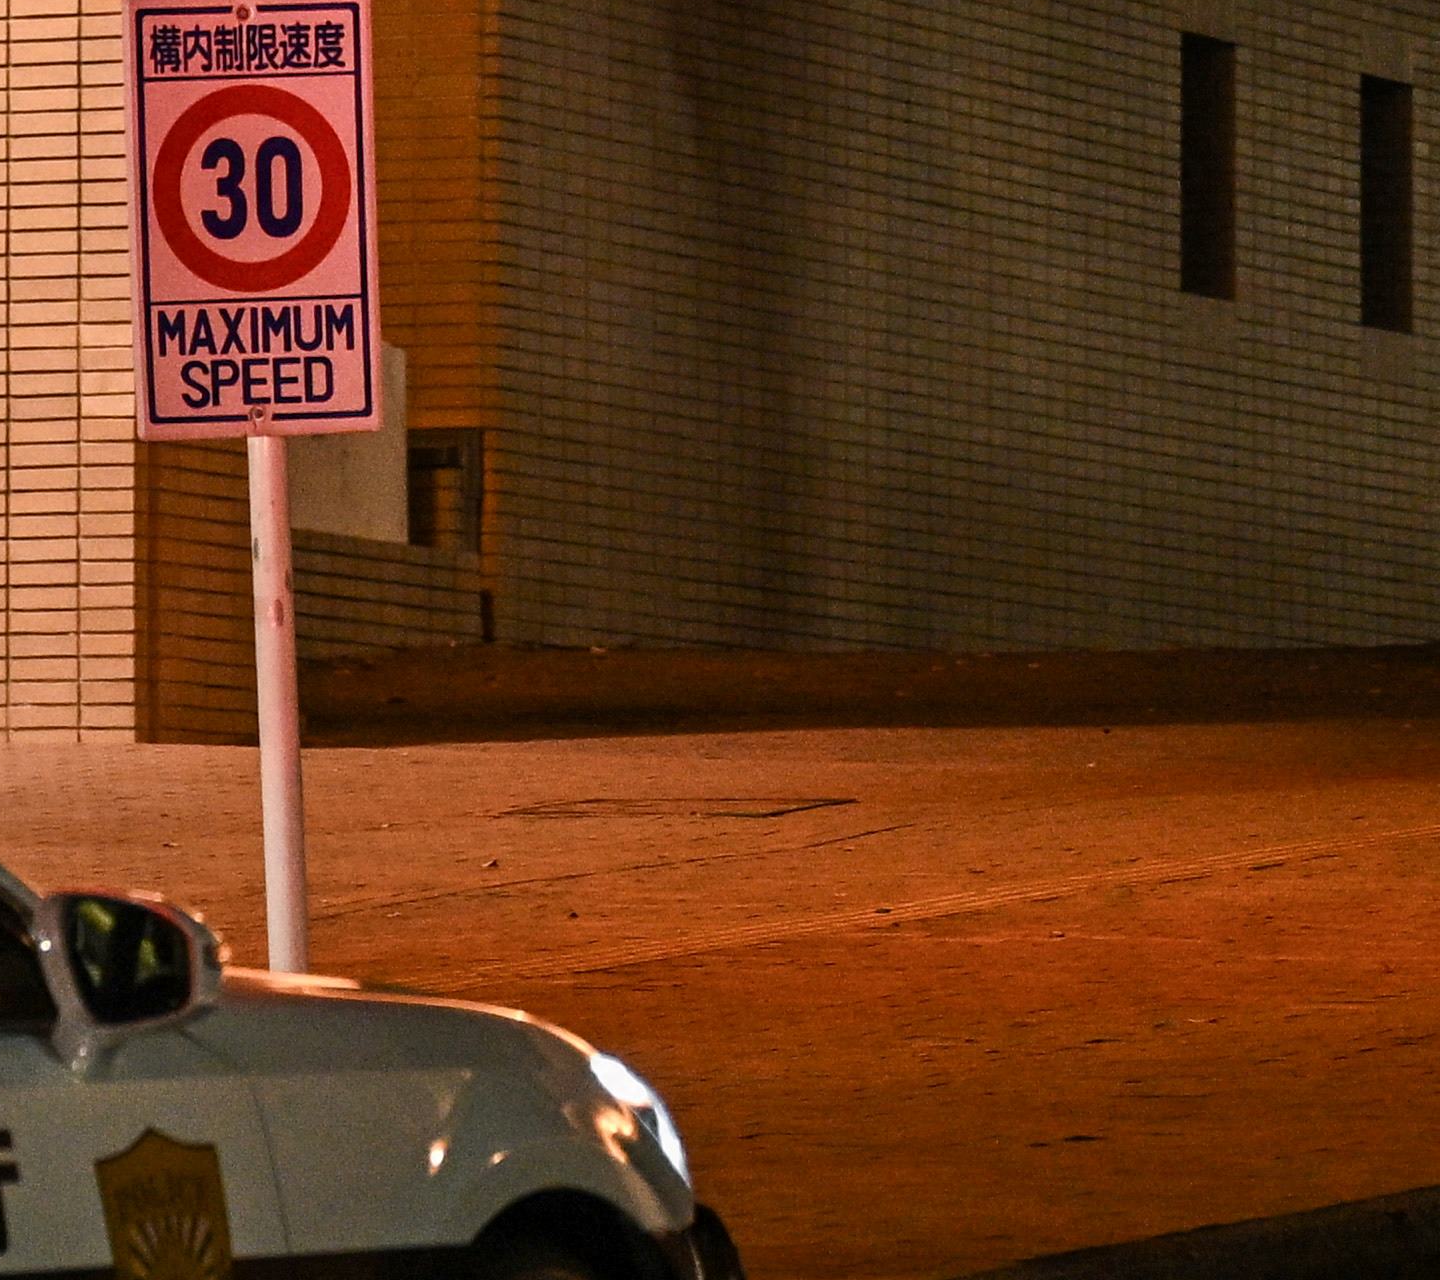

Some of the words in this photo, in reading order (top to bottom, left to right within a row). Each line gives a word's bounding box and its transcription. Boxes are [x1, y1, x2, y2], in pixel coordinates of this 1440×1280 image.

[149, 21, 345, 75] 構内制限速度
[200, 136, 303, 240] 30
[158, 304, 354, 357] MAXIMUM
[181, 357, 334, 408] SPEED
